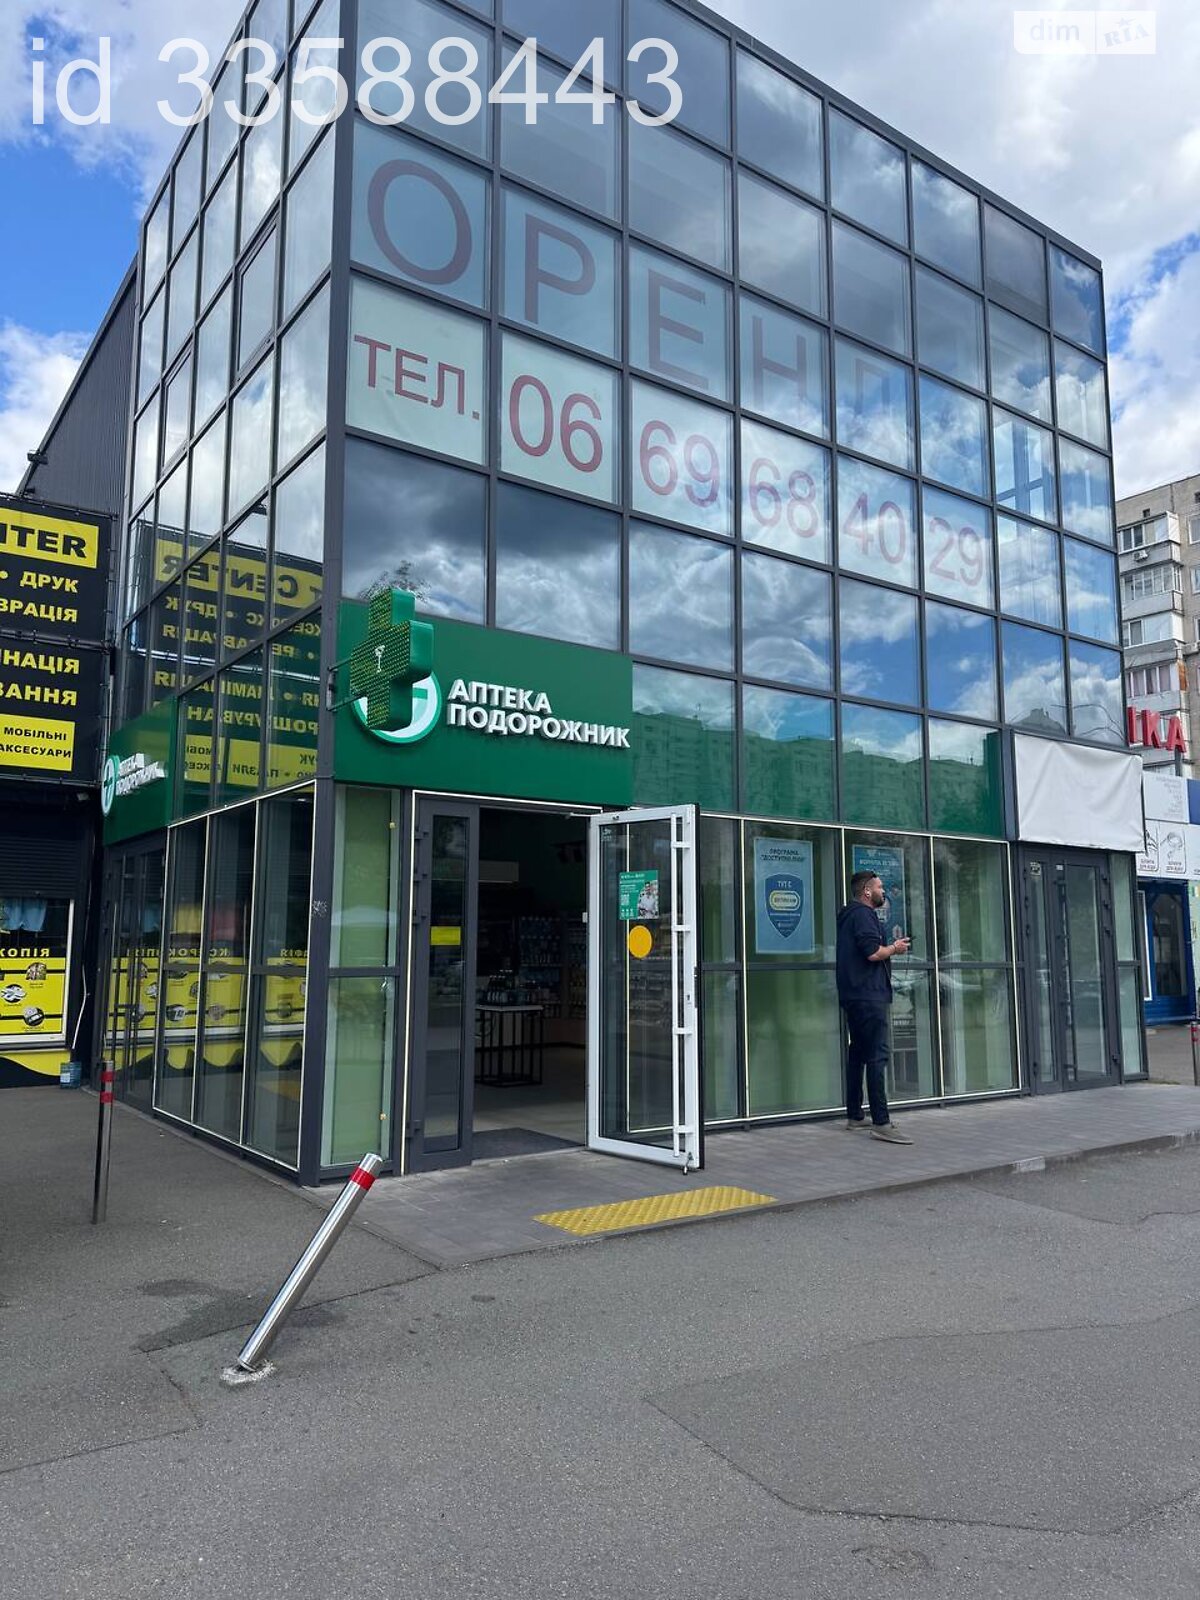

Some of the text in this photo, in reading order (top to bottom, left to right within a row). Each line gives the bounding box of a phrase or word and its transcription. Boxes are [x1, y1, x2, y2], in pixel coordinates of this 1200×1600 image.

[354, 334, 983, 587] ТЕЛ. 06 69 68 40 29
[20, 571, 79, 593] ДРУК
[447, 679, 552, 714] АПТЕКА
[4, 726, 67, 741] МОБІЛЬНІ
[446, 703, 631, 748] ПОДОРОЖНИК
